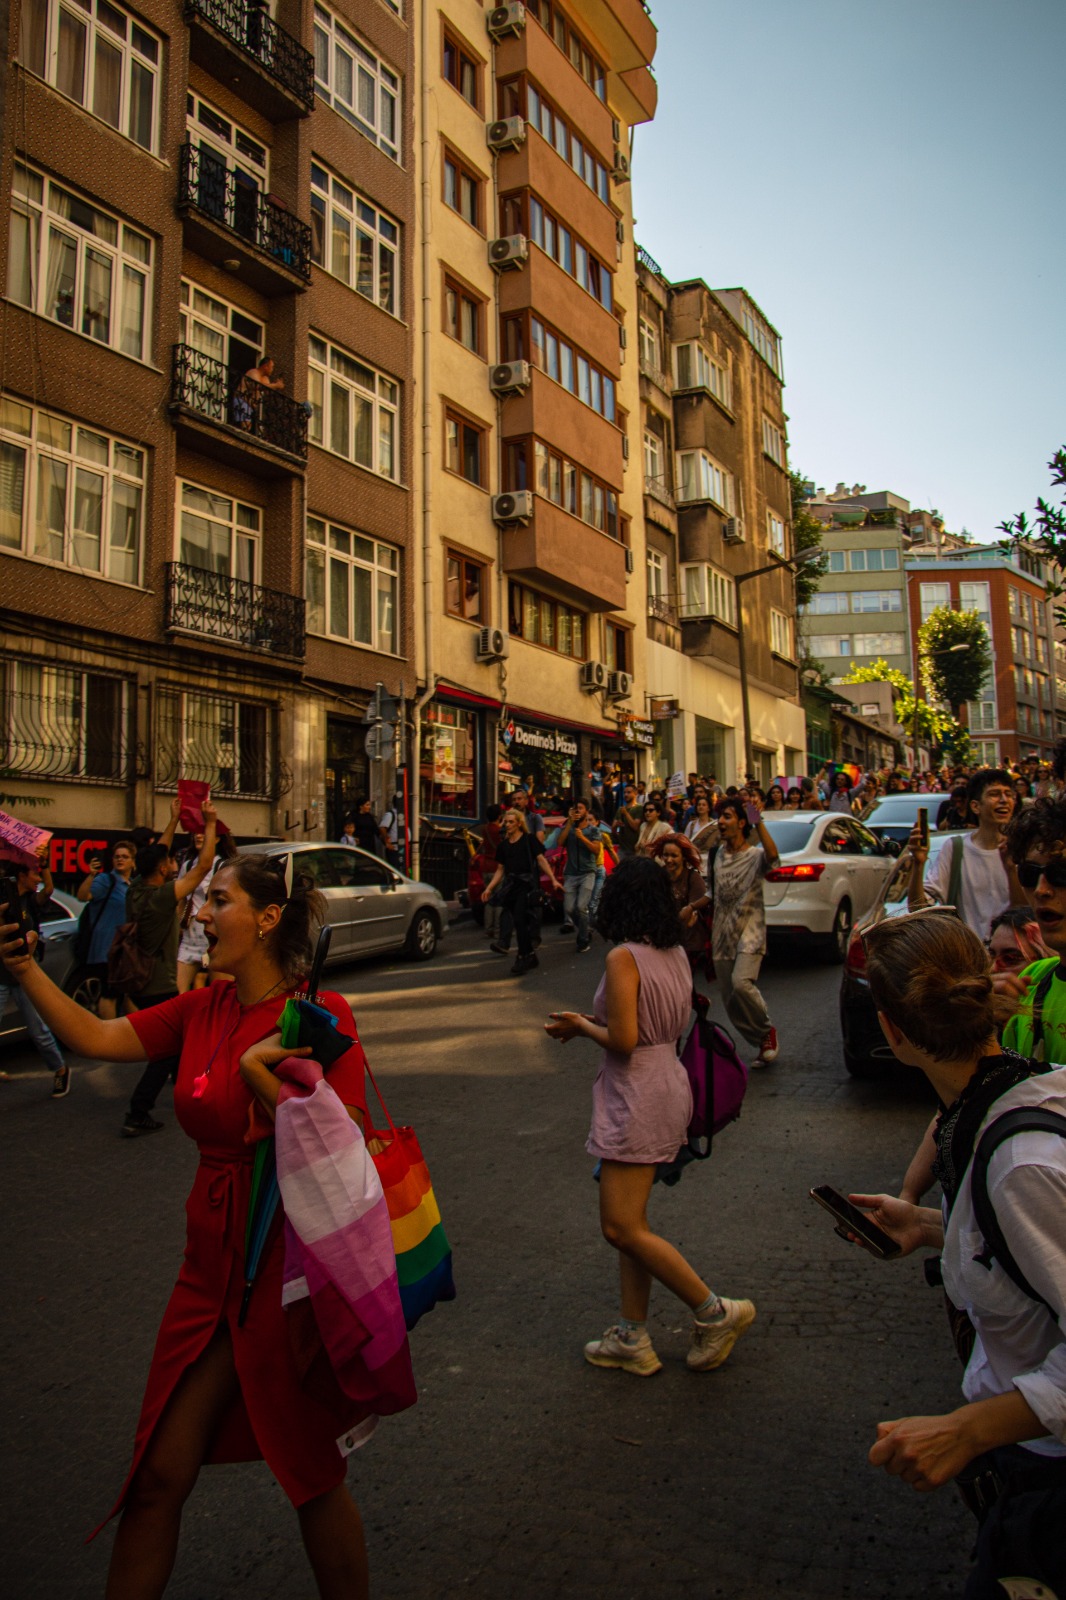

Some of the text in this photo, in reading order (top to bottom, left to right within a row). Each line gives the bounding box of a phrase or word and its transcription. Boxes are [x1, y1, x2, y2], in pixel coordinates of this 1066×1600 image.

[515, 726, 577, 756] Domino's Pizza
[13, 822, 43, 839] DEVLET
[49, 838, 107, 873] FECT
